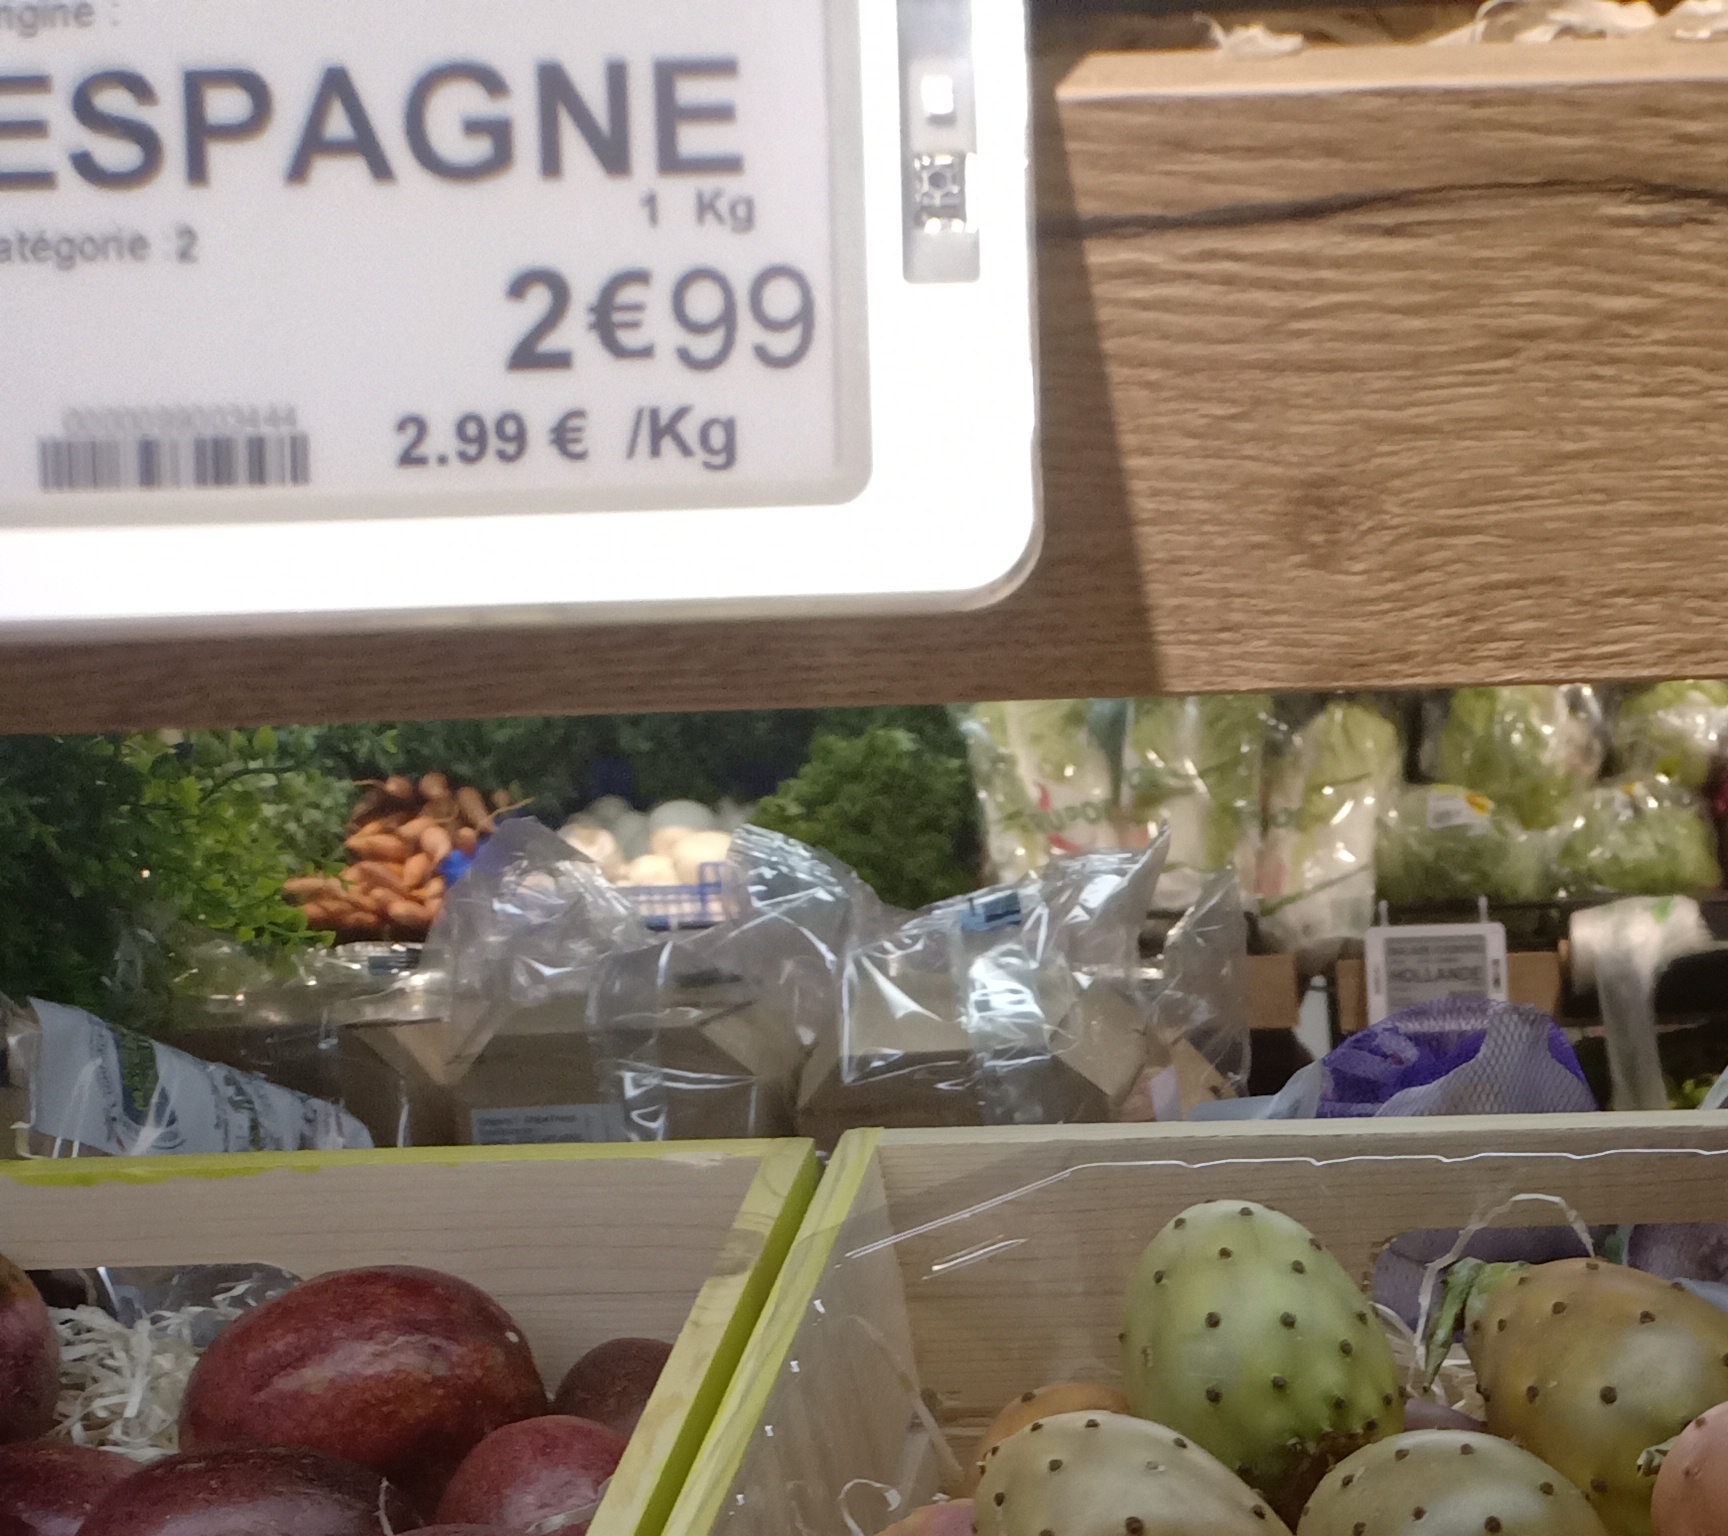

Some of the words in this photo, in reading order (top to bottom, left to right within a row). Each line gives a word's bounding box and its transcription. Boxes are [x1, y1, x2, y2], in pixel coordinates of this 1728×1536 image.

[0, 56, 744, 190] ESPAGNE
[642, 194, 660, 227] 1
[694, 190, 756, 233] Kg
[505, 264, 816, 373] 2€99
[395, 411, 527, 470] 2.99
[549, 410, 590, 463] €
[625, 404, 739, 472] /Kg
